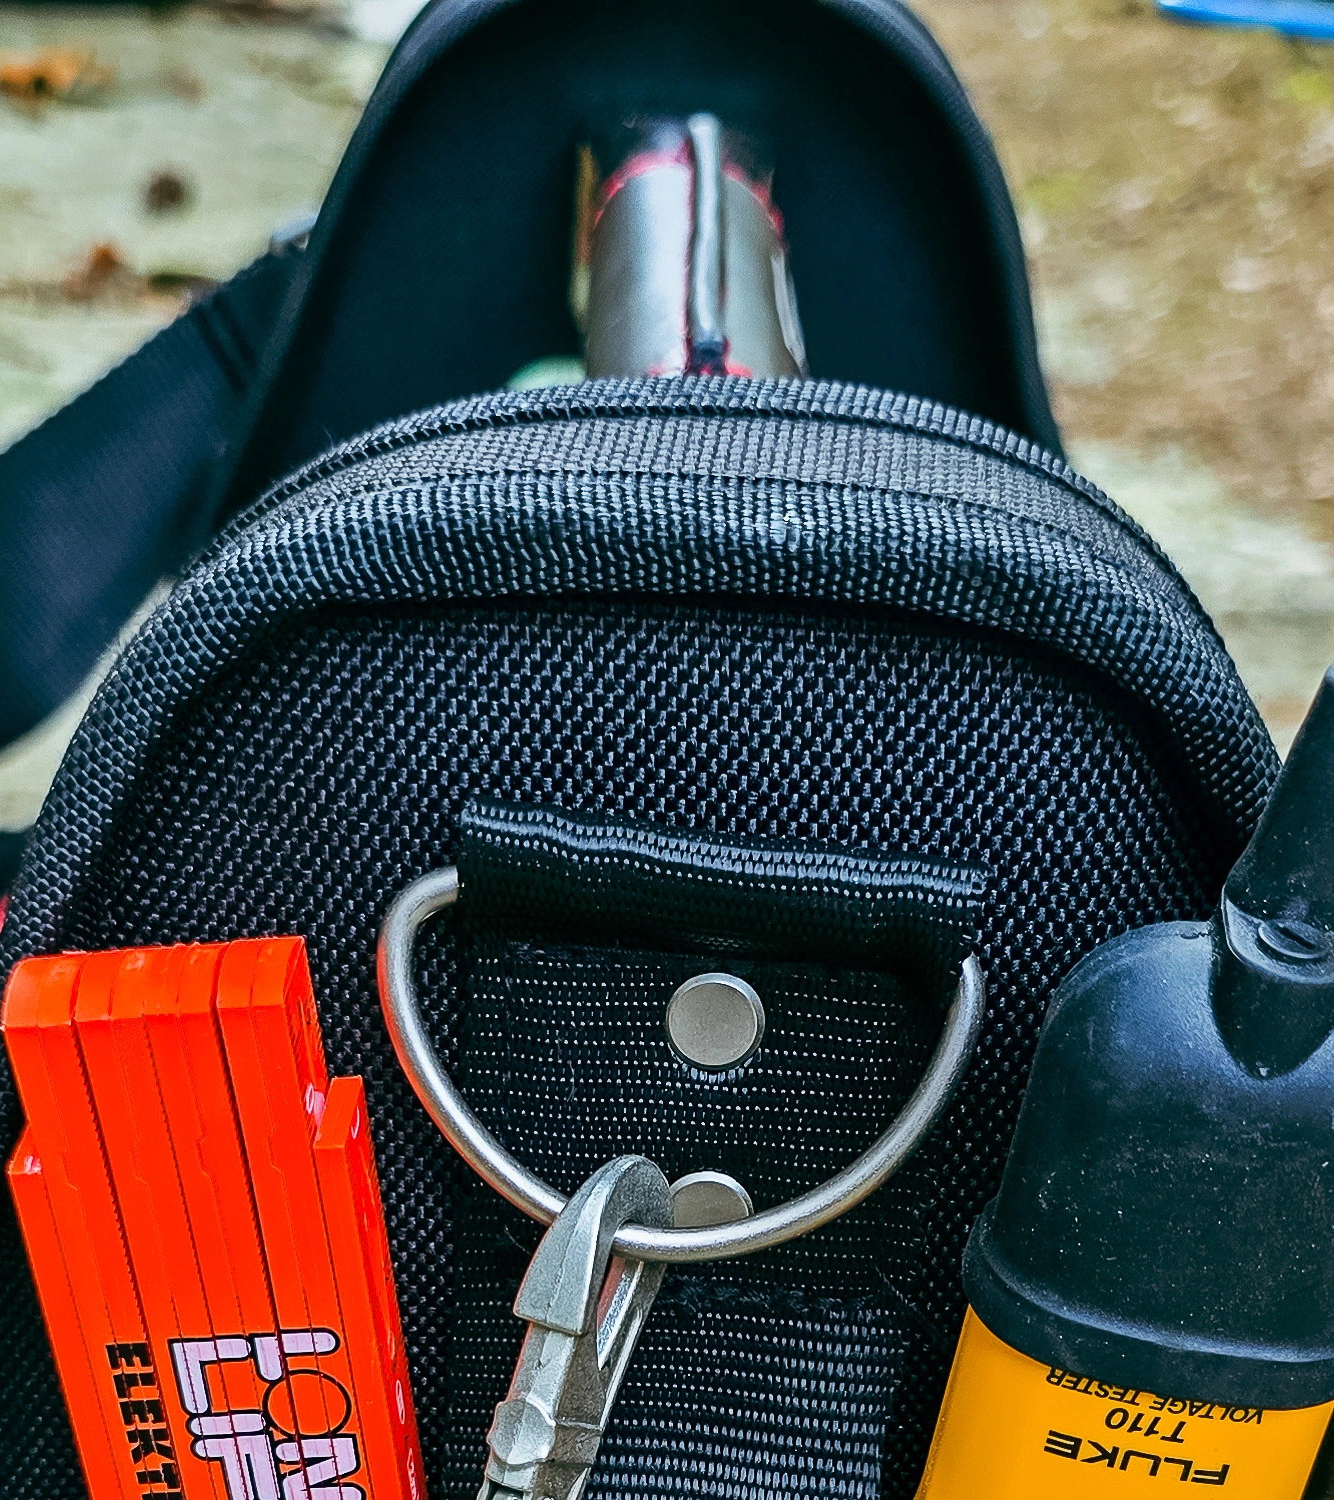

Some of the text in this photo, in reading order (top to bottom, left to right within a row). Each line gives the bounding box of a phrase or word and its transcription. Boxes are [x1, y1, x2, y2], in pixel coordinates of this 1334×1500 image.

[1045, 1366, 1264, 1425] VOLTAGE TESTER
[1104, 1407, 1187, 1444] T110
[1043, 1429, 1230, 1486] FLUKE
